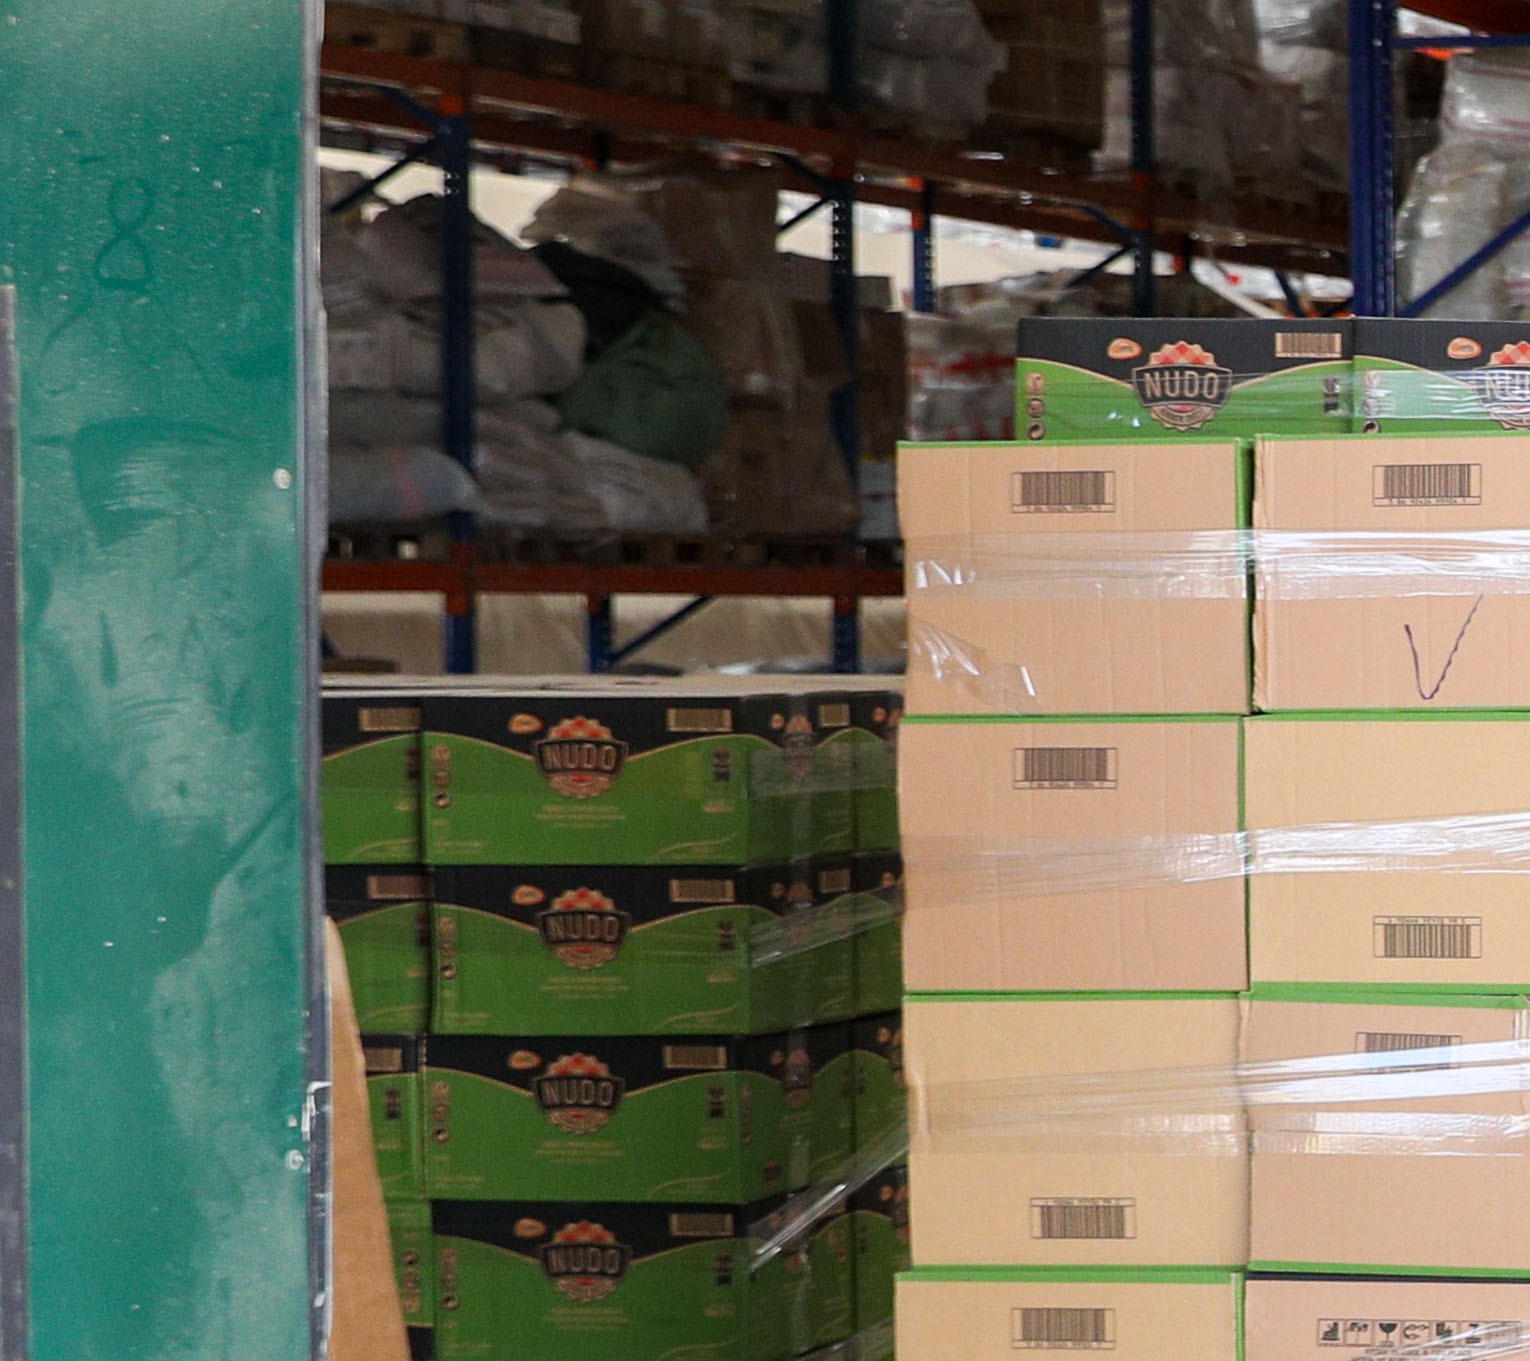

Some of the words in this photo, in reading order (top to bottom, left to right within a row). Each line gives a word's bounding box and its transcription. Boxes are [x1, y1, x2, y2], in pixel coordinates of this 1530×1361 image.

[1143, 371, 1220, 399] NUDO
[543, 743, 617, 770] NUDO
[549, 914, 619, 940] NUDO
[543, 1080, 615, 1106] NUDO
[551, 1247, 620, 1273] NUDO
